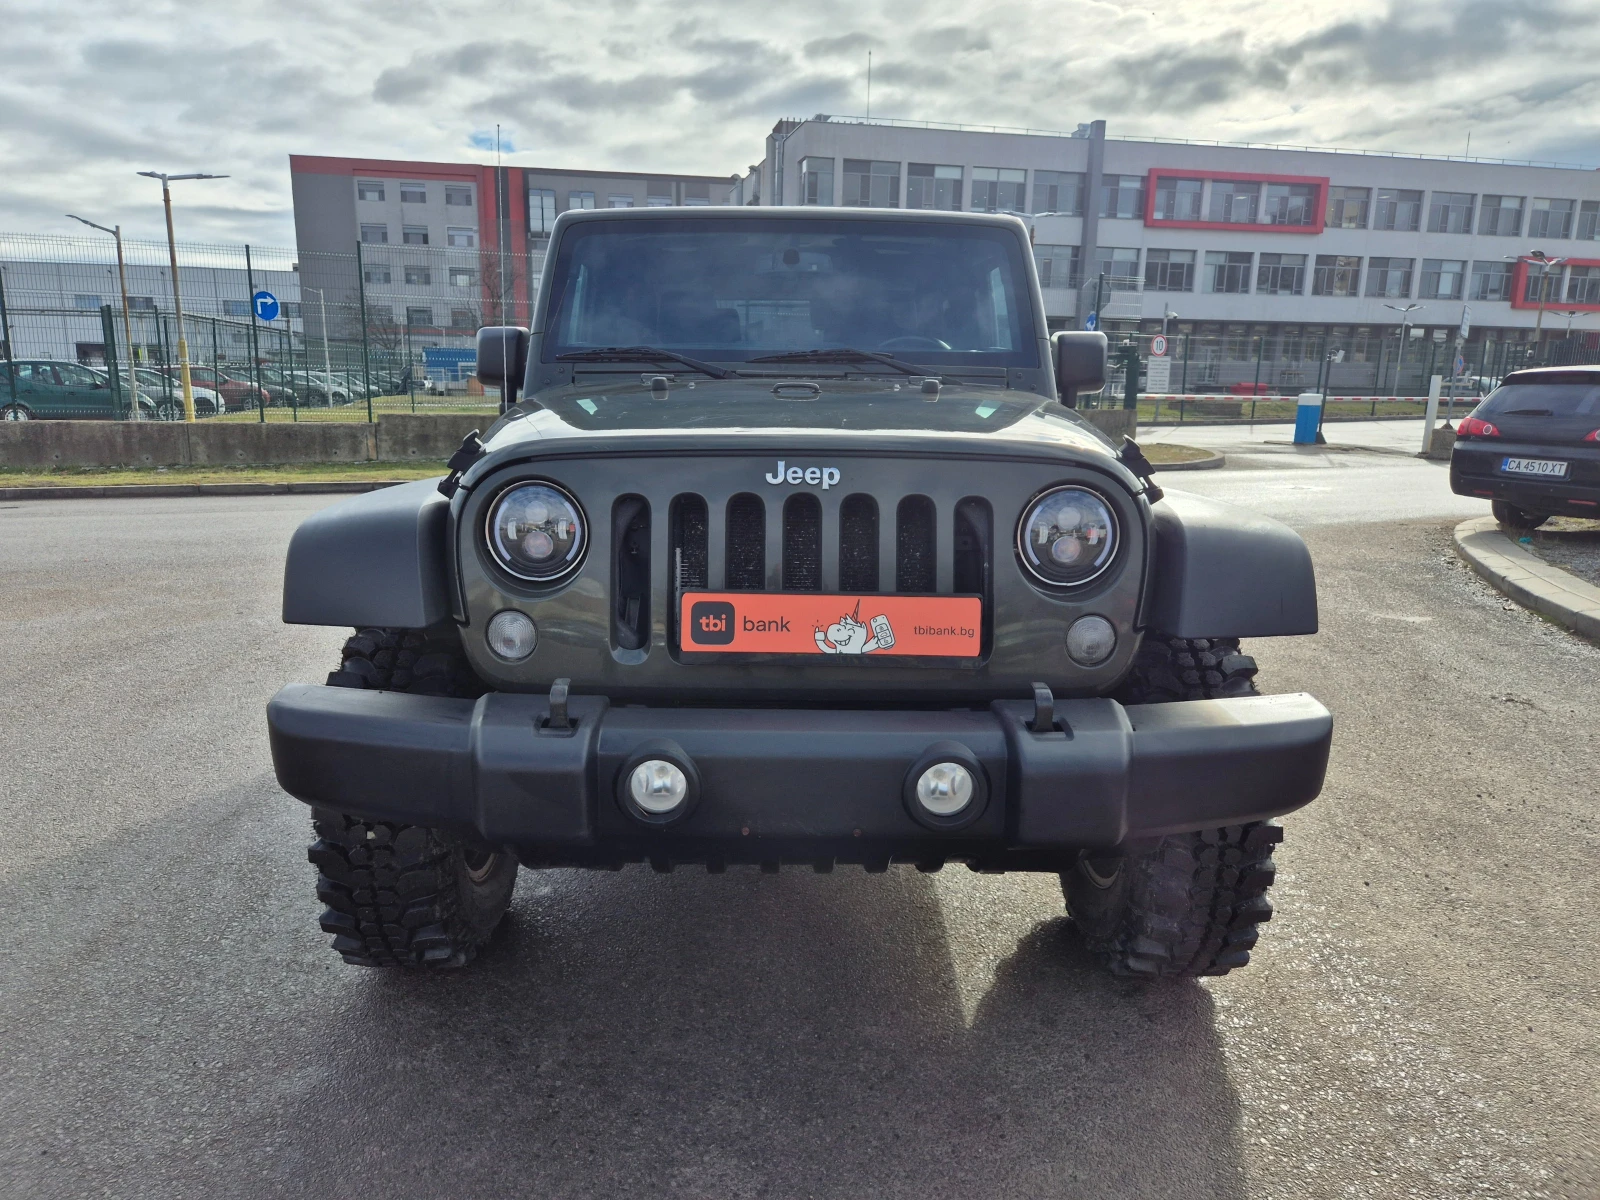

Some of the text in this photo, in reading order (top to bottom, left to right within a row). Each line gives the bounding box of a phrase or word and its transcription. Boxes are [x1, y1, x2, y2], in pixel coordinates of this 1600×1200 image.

[1156, 340, 1164, 351] 10
[1508, 460, 1565, 474] CA 4510 XT
[765, 460, 841, 490] Jeep
[699, 614, 791, 633] tbi bank
[913, 625, 975, 639] tbibank.bg
